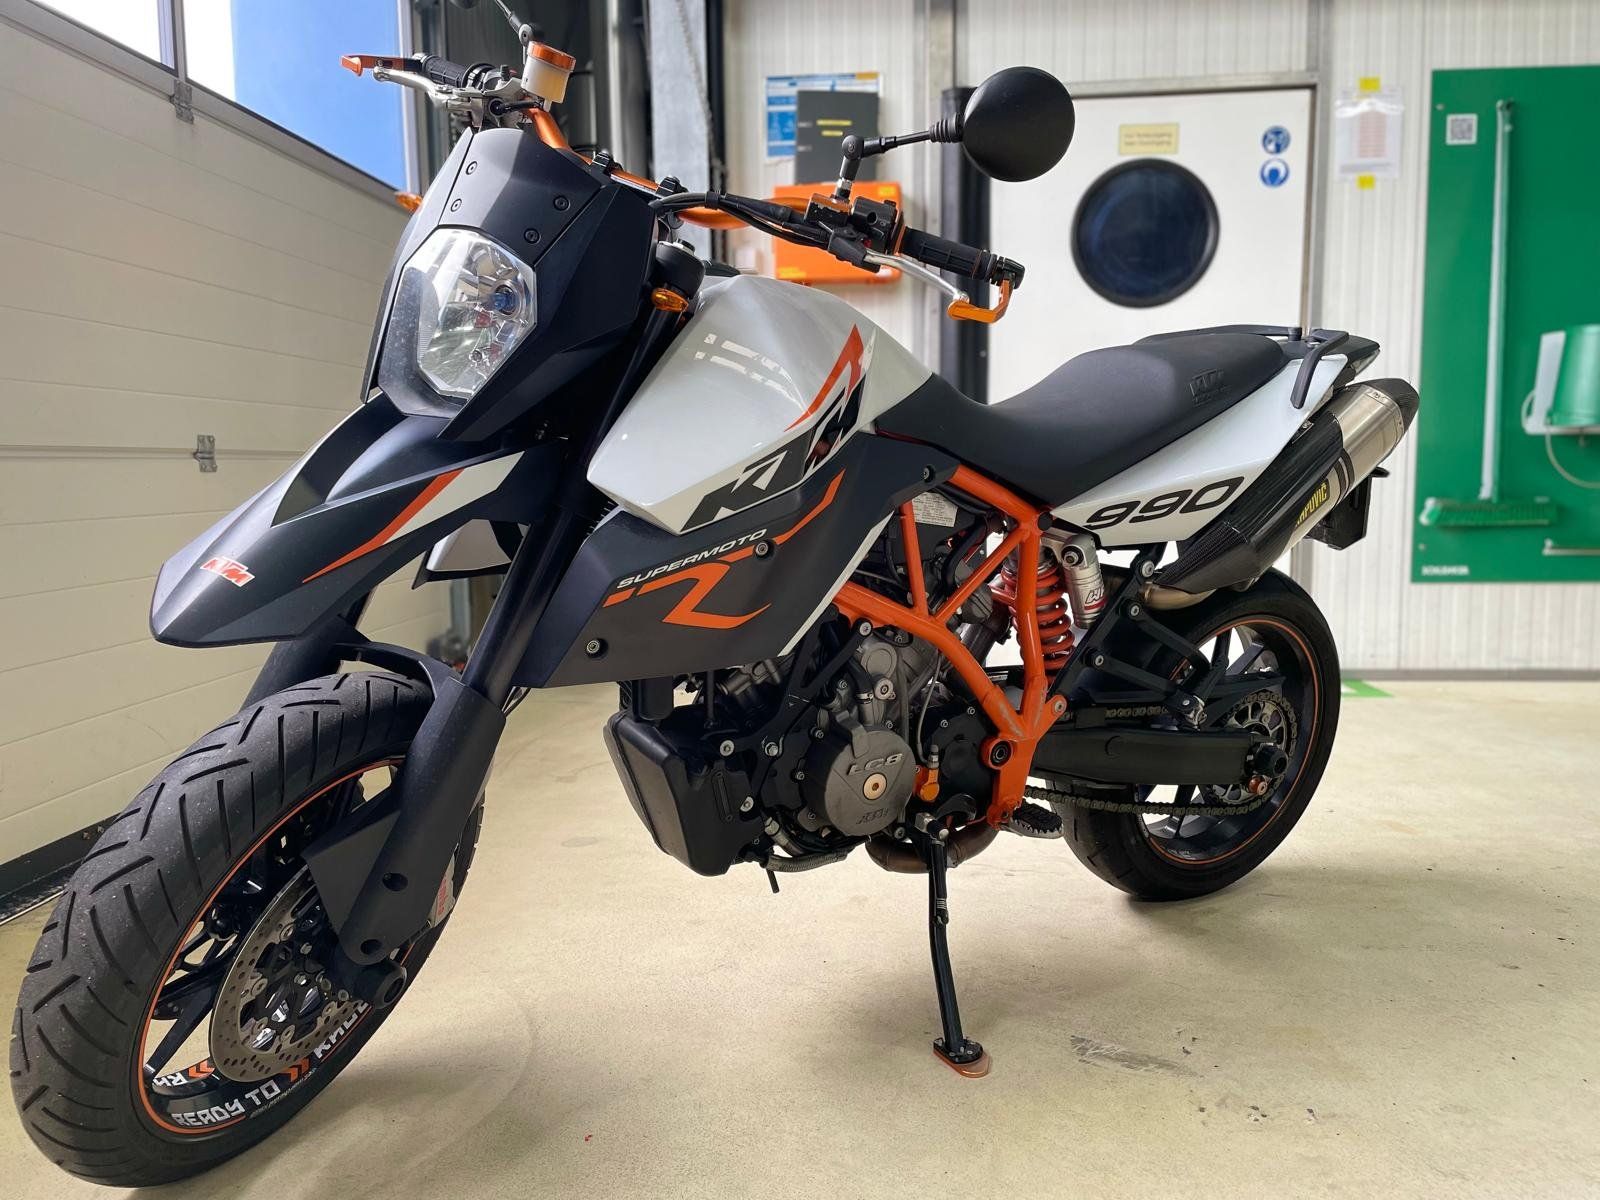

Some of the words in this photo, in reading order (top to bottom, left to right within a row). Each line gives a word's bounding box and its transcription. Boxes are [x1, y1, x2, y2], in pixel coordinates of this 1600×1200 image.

[1082, 476, 1245, 530] 990
[617, 529, 767, 589] SUPERMOTO
[846, 753, 903, 776] LC8
[171, 1099, 245, 1127] READY
[245, 1080, 281, 1106] TO
